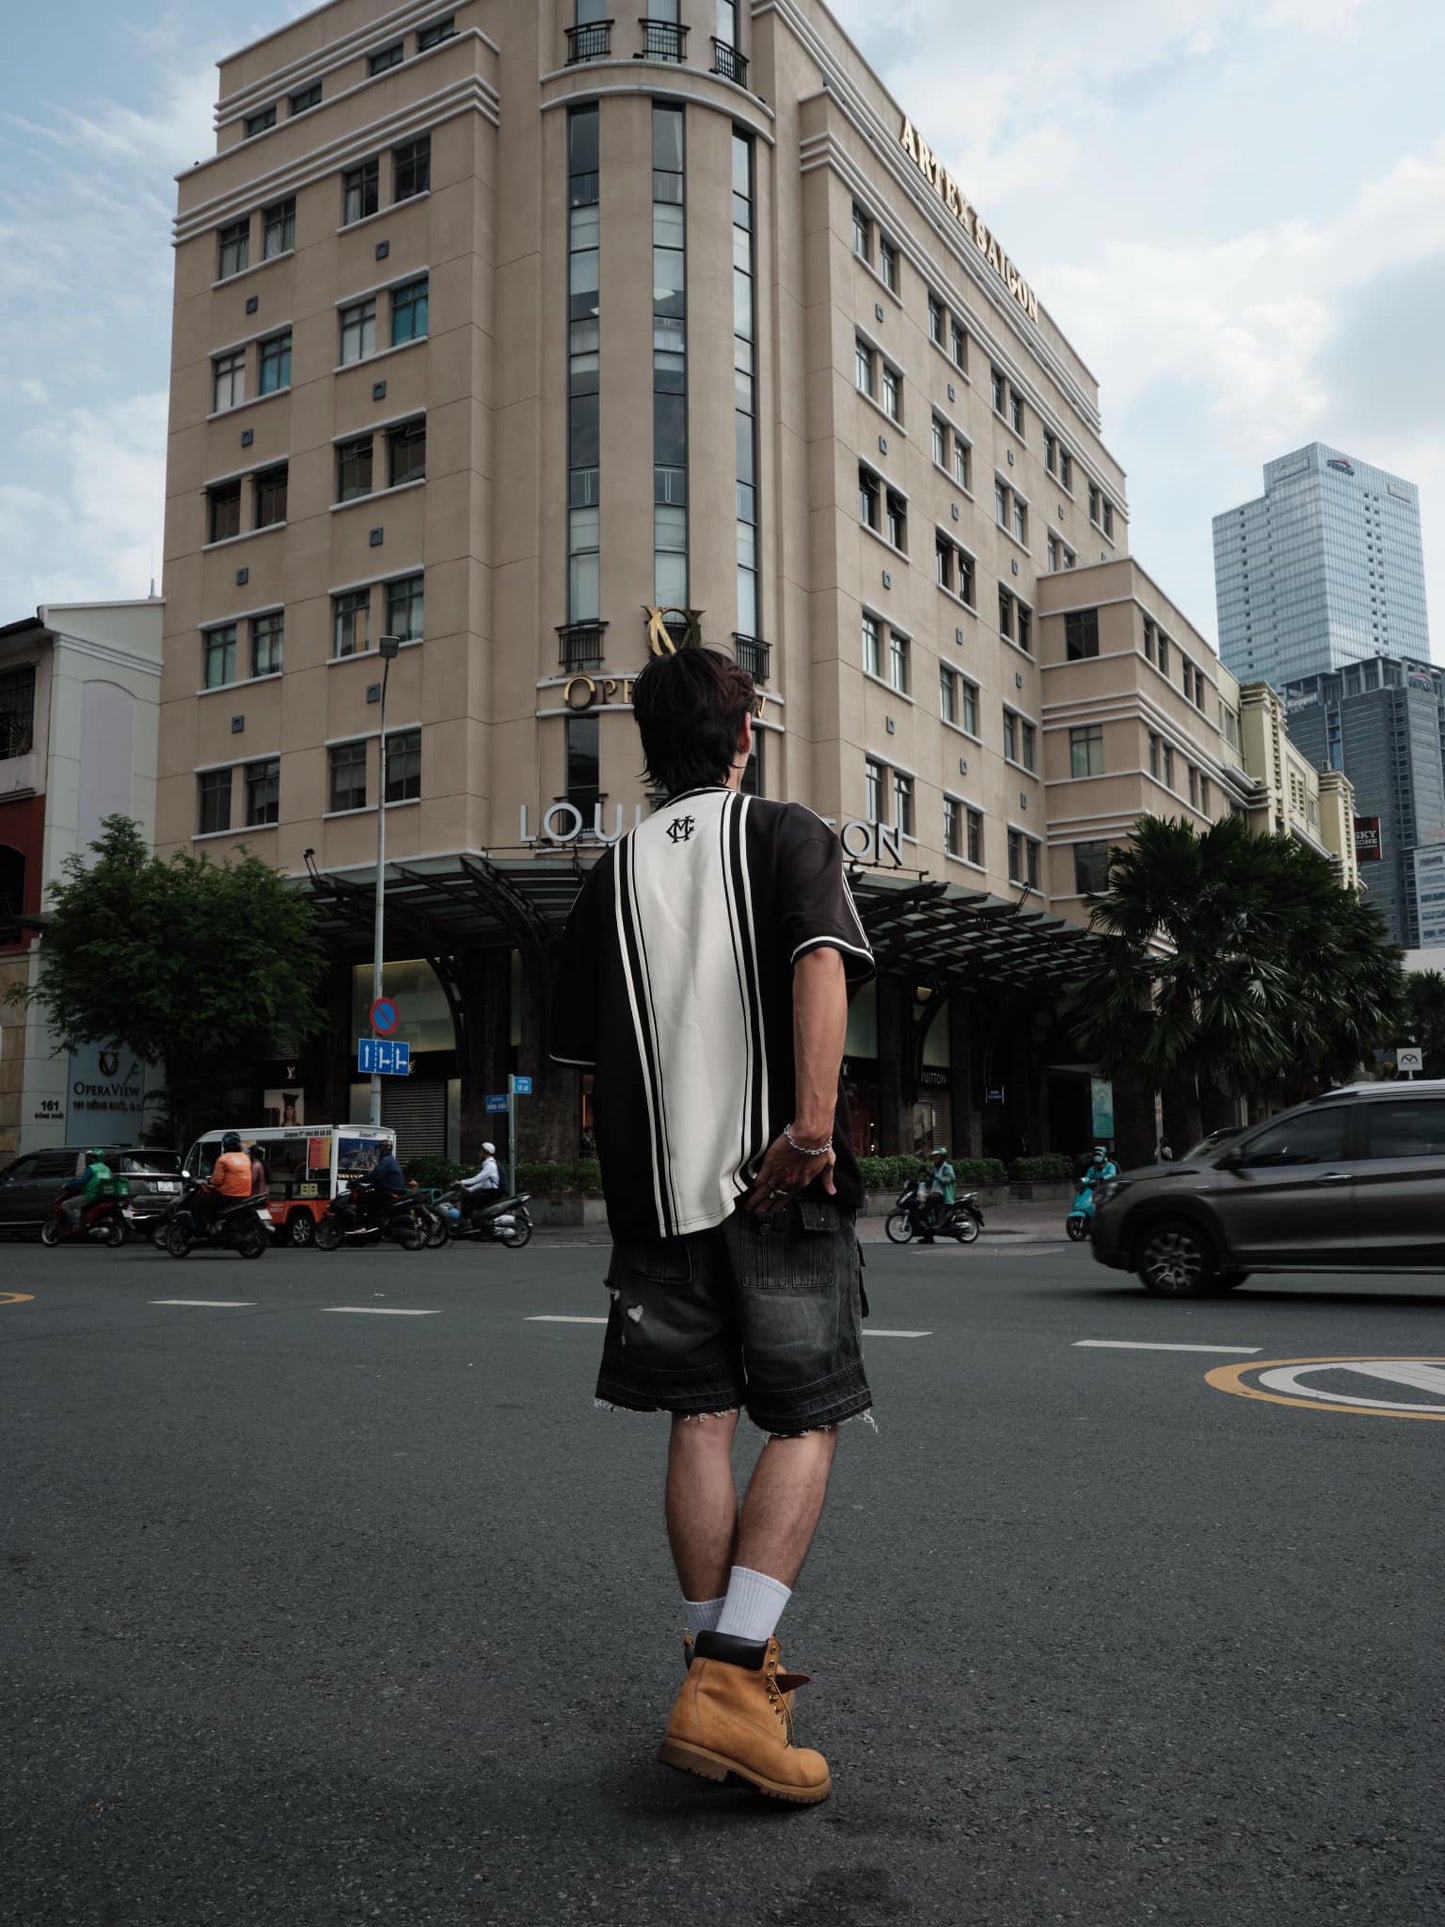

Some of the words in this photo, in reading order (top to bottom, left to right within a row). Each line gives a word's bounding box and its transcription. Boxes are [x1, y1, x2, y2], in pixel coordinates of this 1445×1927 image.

[972, 216, 1039, 325] SAIGON
[520, 802, 642, 842] LOUI
[41, 1100, 59, 1111] 161
